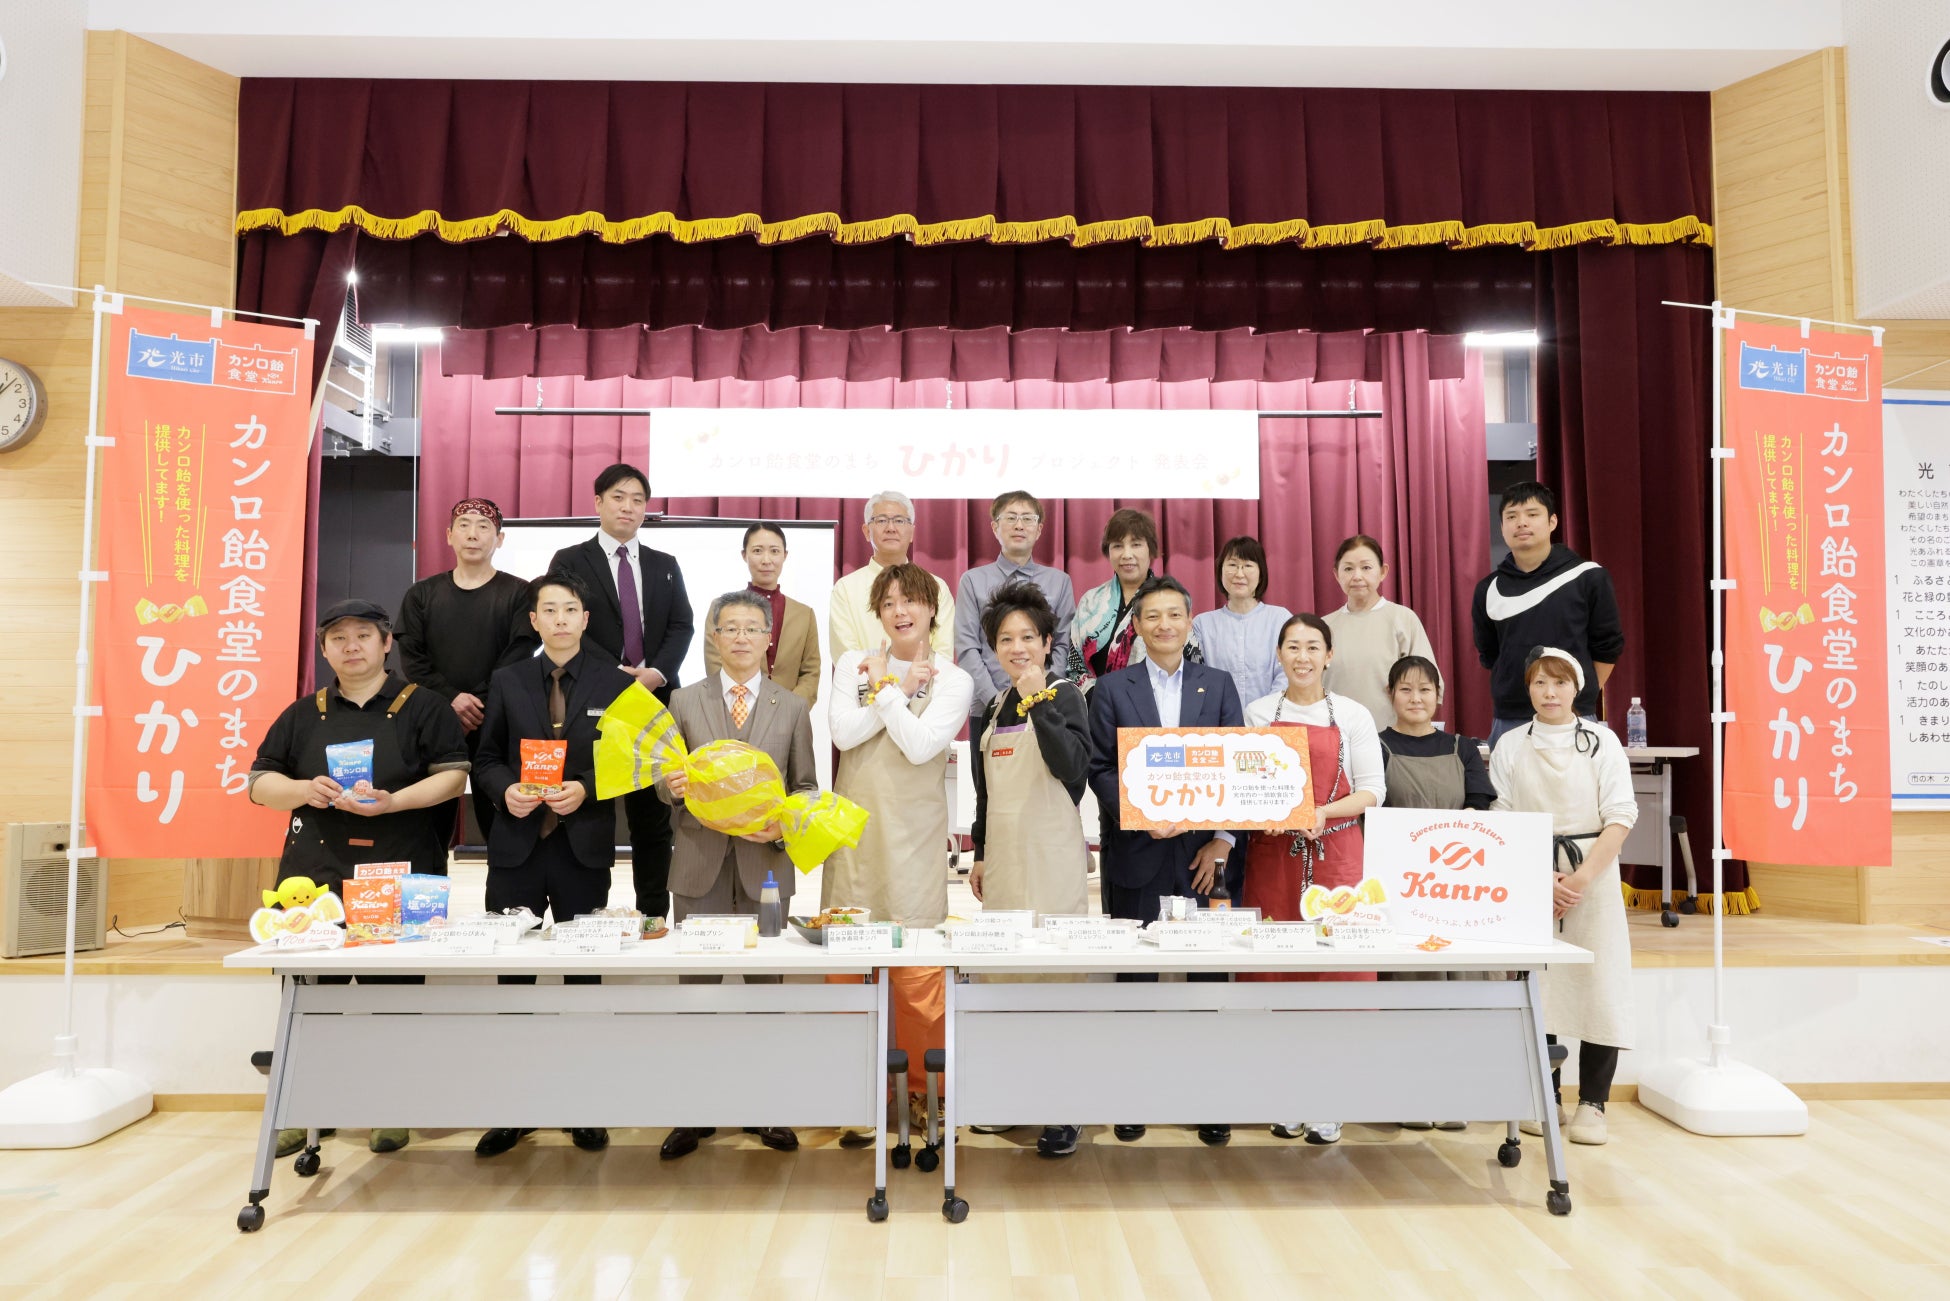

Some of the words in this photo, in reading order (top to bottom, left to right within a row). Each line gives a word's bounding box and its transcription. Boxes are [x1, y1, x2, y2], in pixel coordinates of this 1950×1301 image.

[169, 350, 205, 367] 光市
[228, 354, 285, 372] カンロ飴
[227, 368, 259, 383] 食堂
[1771, 361, 1799, 377] 光市
[1815, 363, 1858, 378] カンロ飴
[14, 384, 22, 393] 2
[1815, 376, 1839, 391] 食堂
[19, 399, 27, 408] 3
[13, 414, 21, 423] 4
[1, 426, 9, 435] 5
[708, 452, 879, 470] カンロ飴食堂のまち
[898, 441, 1011, 478] ひかり
[1031, 452, 1139, 470] プロジェクト
[1154, 453, 1209, 470] 発表会
[1899, 489, 1950, 498] わたくしたち
[173, 425, 192, 582] カンロ飴を使った料理を
[1781, 435, 1799, 590] カンロ飴を使った料理を
[216, 414, 271, 795] カンロ飴食堂のまち
[1820, 422, 1858, 803] カンロ飴食堂のまち
[1915, 610, 1950, 620] こころ
[1904, 626, 1950, 637] 文化のか
[1916, 644, 1950, 655] あたた
[1917, 680, 1948, 690] たのし
[1907, 697, 1949, 707] 活力のあ
[1919, 716, 1950, 726] きまり
[133, 635, 202, 825] ひかり
[1763, 642, 1815, 831] ひかり
[1909, 732, 1950, 742] しあわせ
[1164, 751, 1181, 760] 光市
[524, 761, 559, 771] Kanro
[1147, 771, 1226, 781] カンロ飴食堂のまち
[1147, 783, 1226, 807] ひかり
[1409, 821, 1451, 842] Sweeten
[1452, 819, 1470, 829] the
[1471, 821, 1506, 846] Future
[1400, 871, 1509, 903] Kanro
